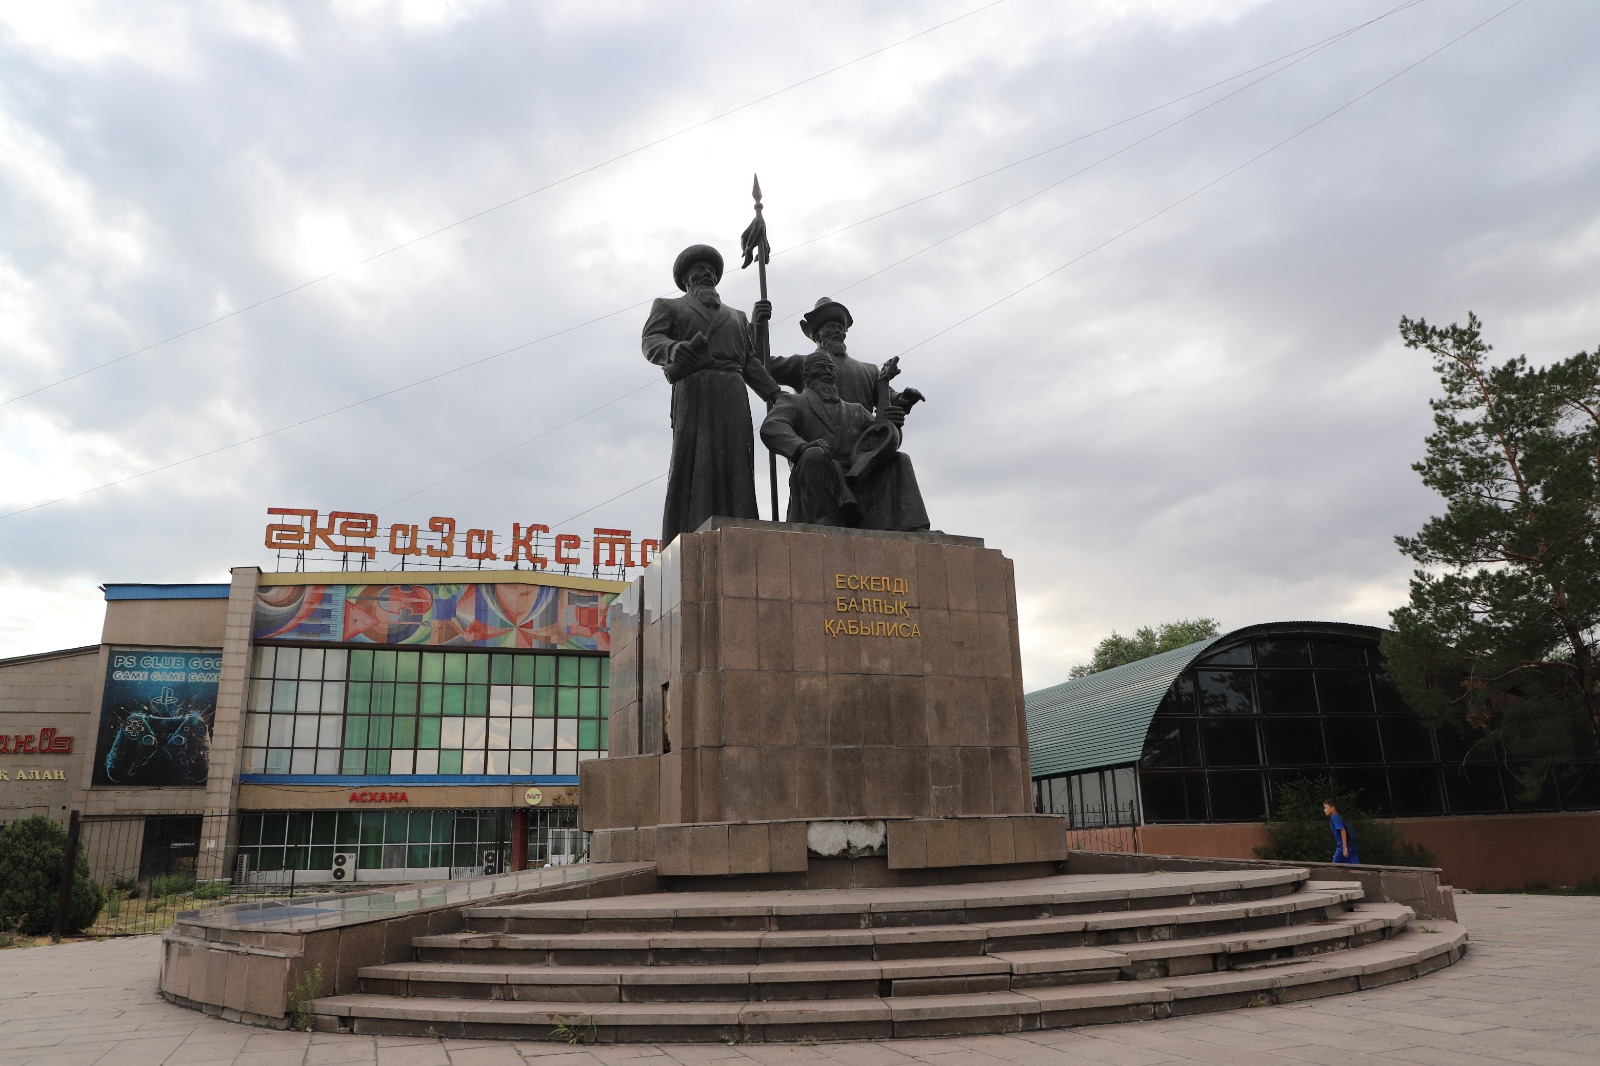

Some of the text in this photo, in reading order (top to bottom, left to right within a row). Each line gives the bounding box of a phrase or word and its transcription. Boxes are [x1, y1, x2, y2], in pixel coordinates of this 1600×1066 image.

[835, 574, 909, 595] ЕСКЕЛДІ
[836, 597, 910, 619] БАЛПЫҚ
[824, 618, 921, 638] ҚАБЫЛИСА
[114, 656, 136, 668] PS
[140, 657, 185, 669] CLUB
[112, 671, 221, 683] GAME GAME GAME
[16, 769, 67, 781] АЛАҢ
[349, 791, 409, 803] АСХАНА
